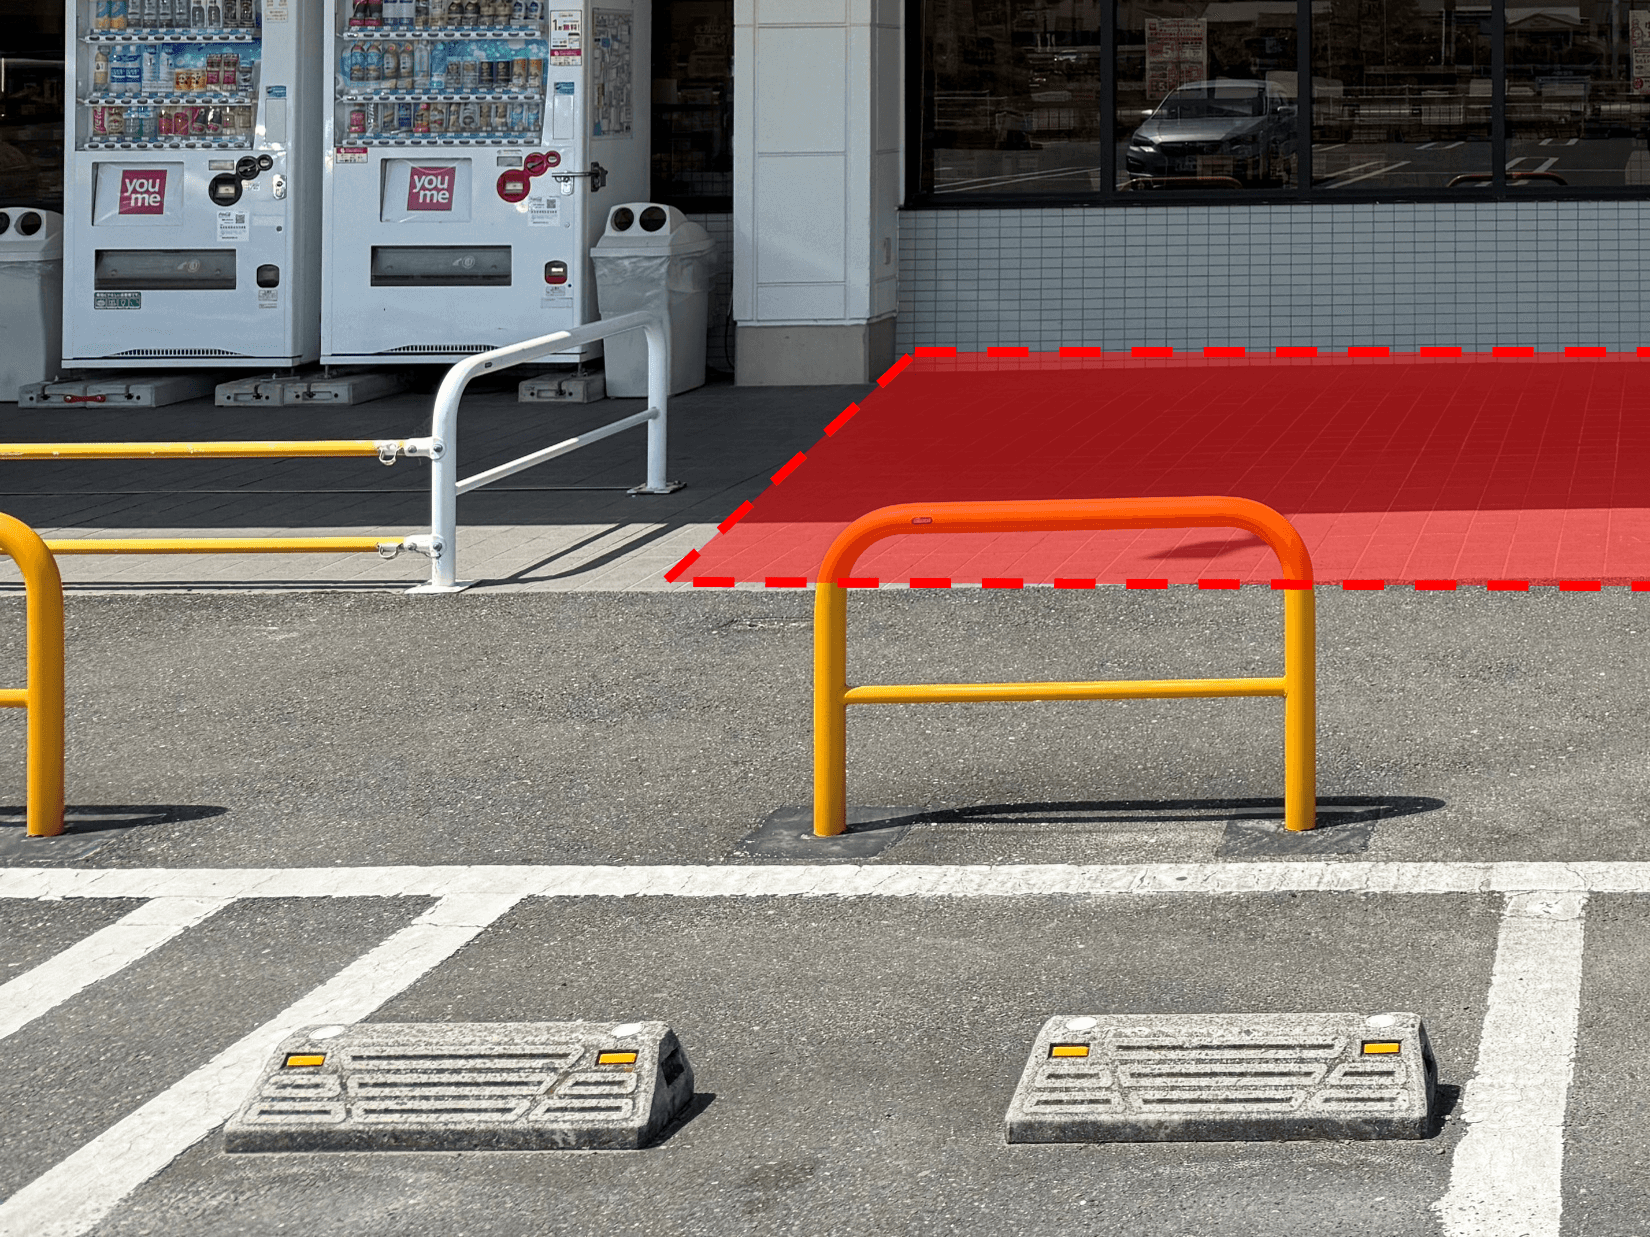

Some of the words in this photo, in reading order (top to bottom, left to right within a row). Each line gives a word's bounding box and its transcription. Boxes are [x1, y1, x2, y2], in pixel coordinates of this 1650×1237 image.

[125, 177, 160, 196] you
[413, 174, 449, 193] you
[130, 192, 161, 207] me
[419, 188, 450, 203] me
